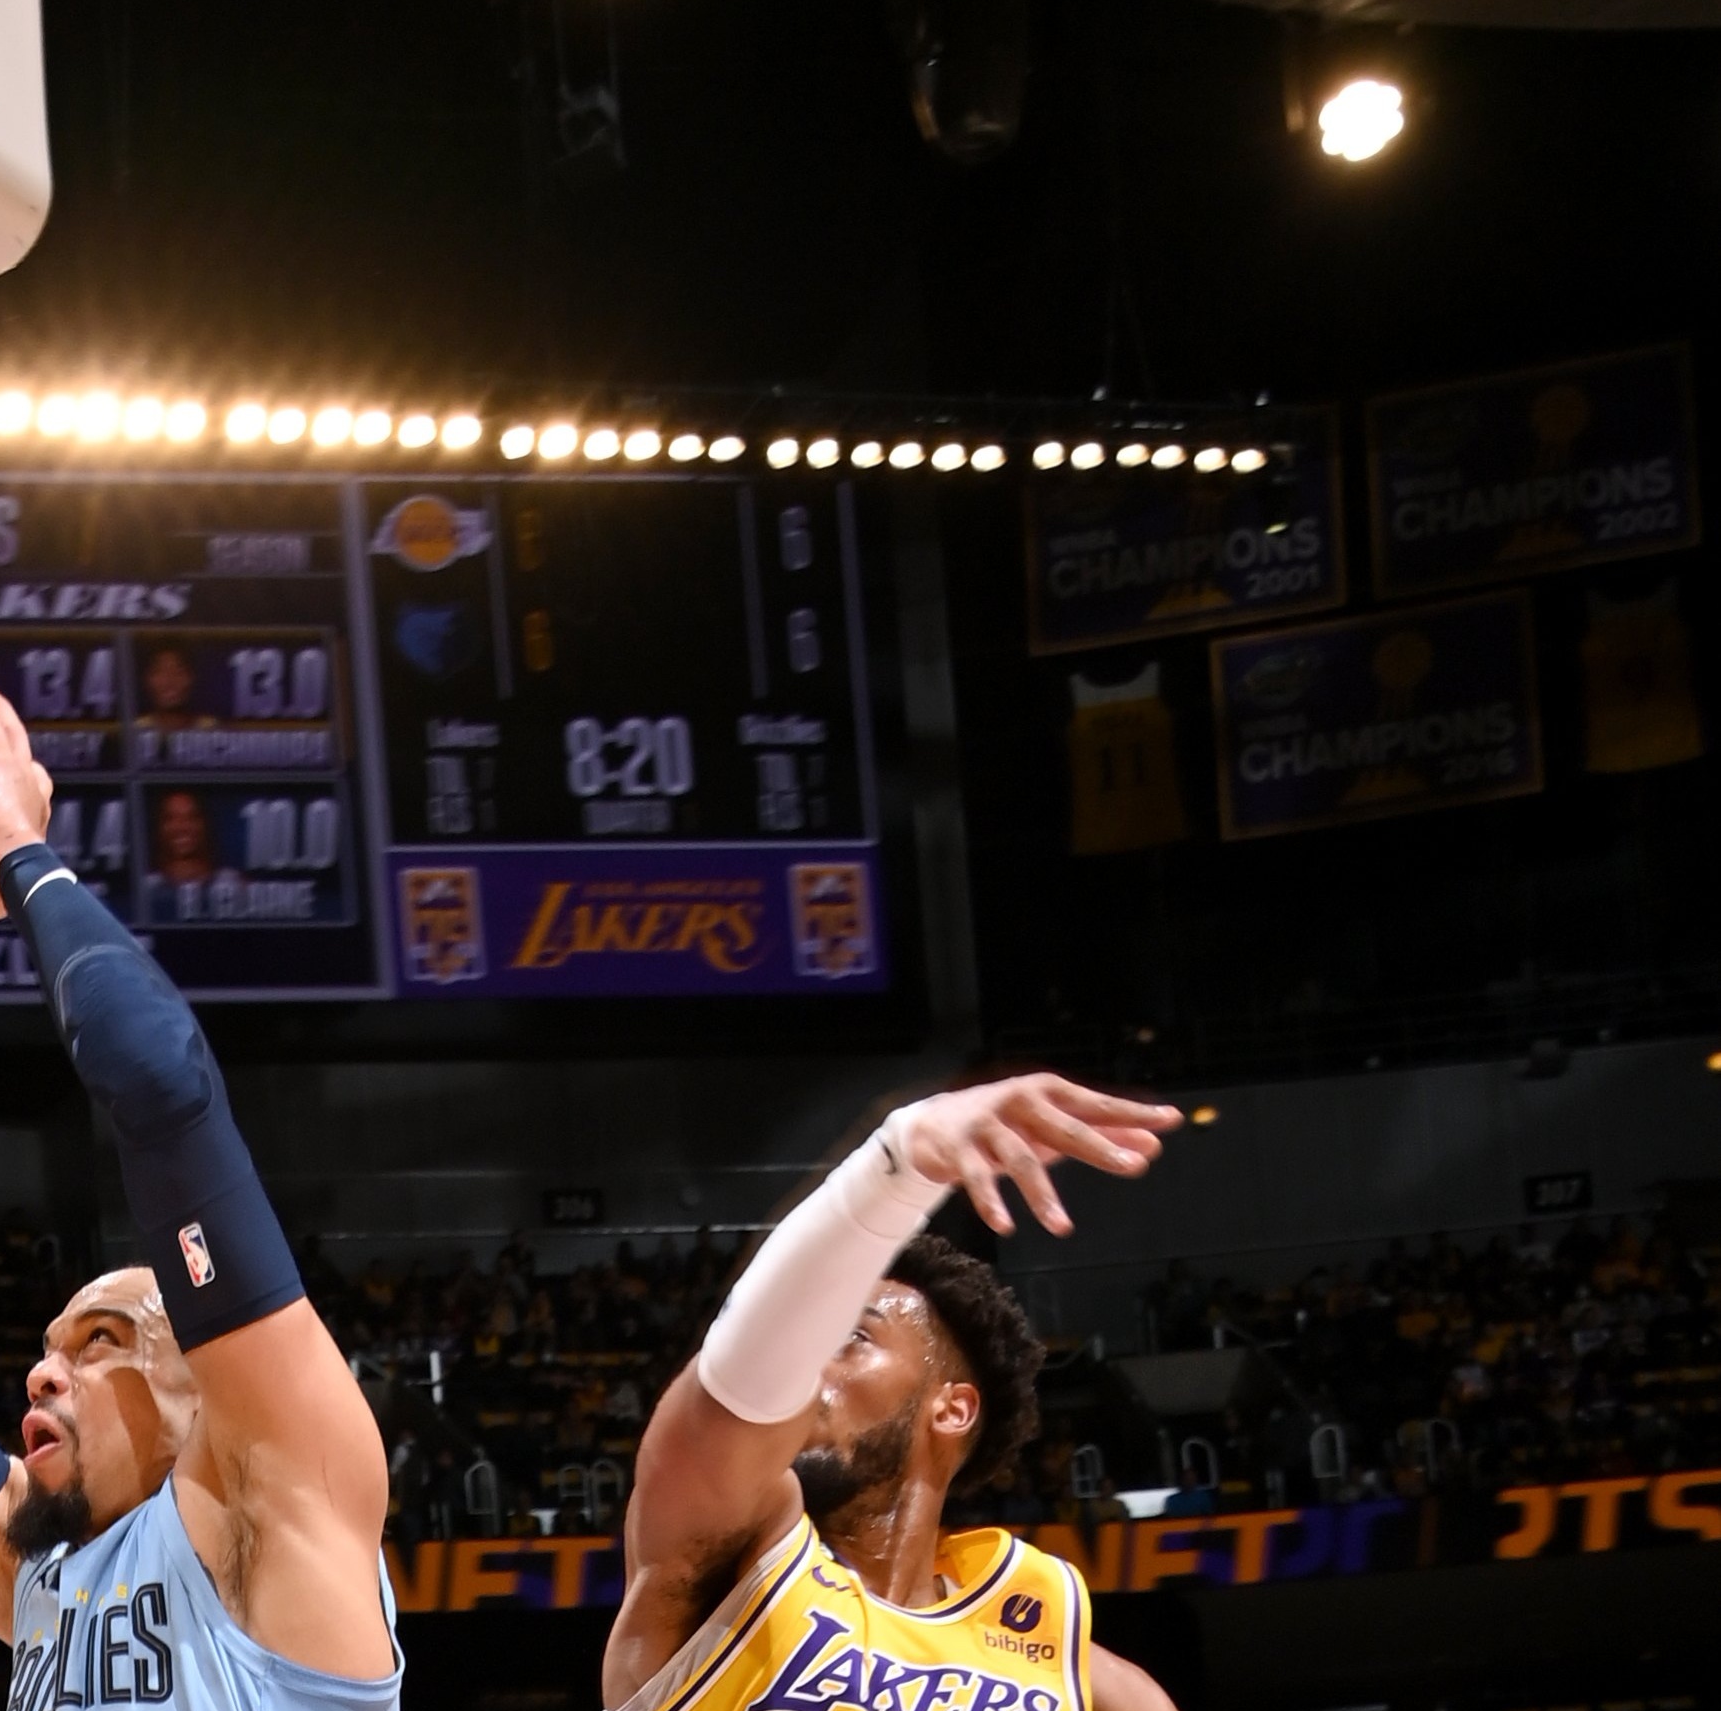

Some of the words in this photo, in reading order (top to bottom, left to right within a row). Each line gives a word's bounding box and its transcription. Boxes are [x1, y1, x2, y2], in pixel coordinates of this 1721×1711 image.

[564, 715, 693, 797] 8:20
[509, 881, 766, 974] LAKERS
[984, 1631, 1056, 1663] bibigo
